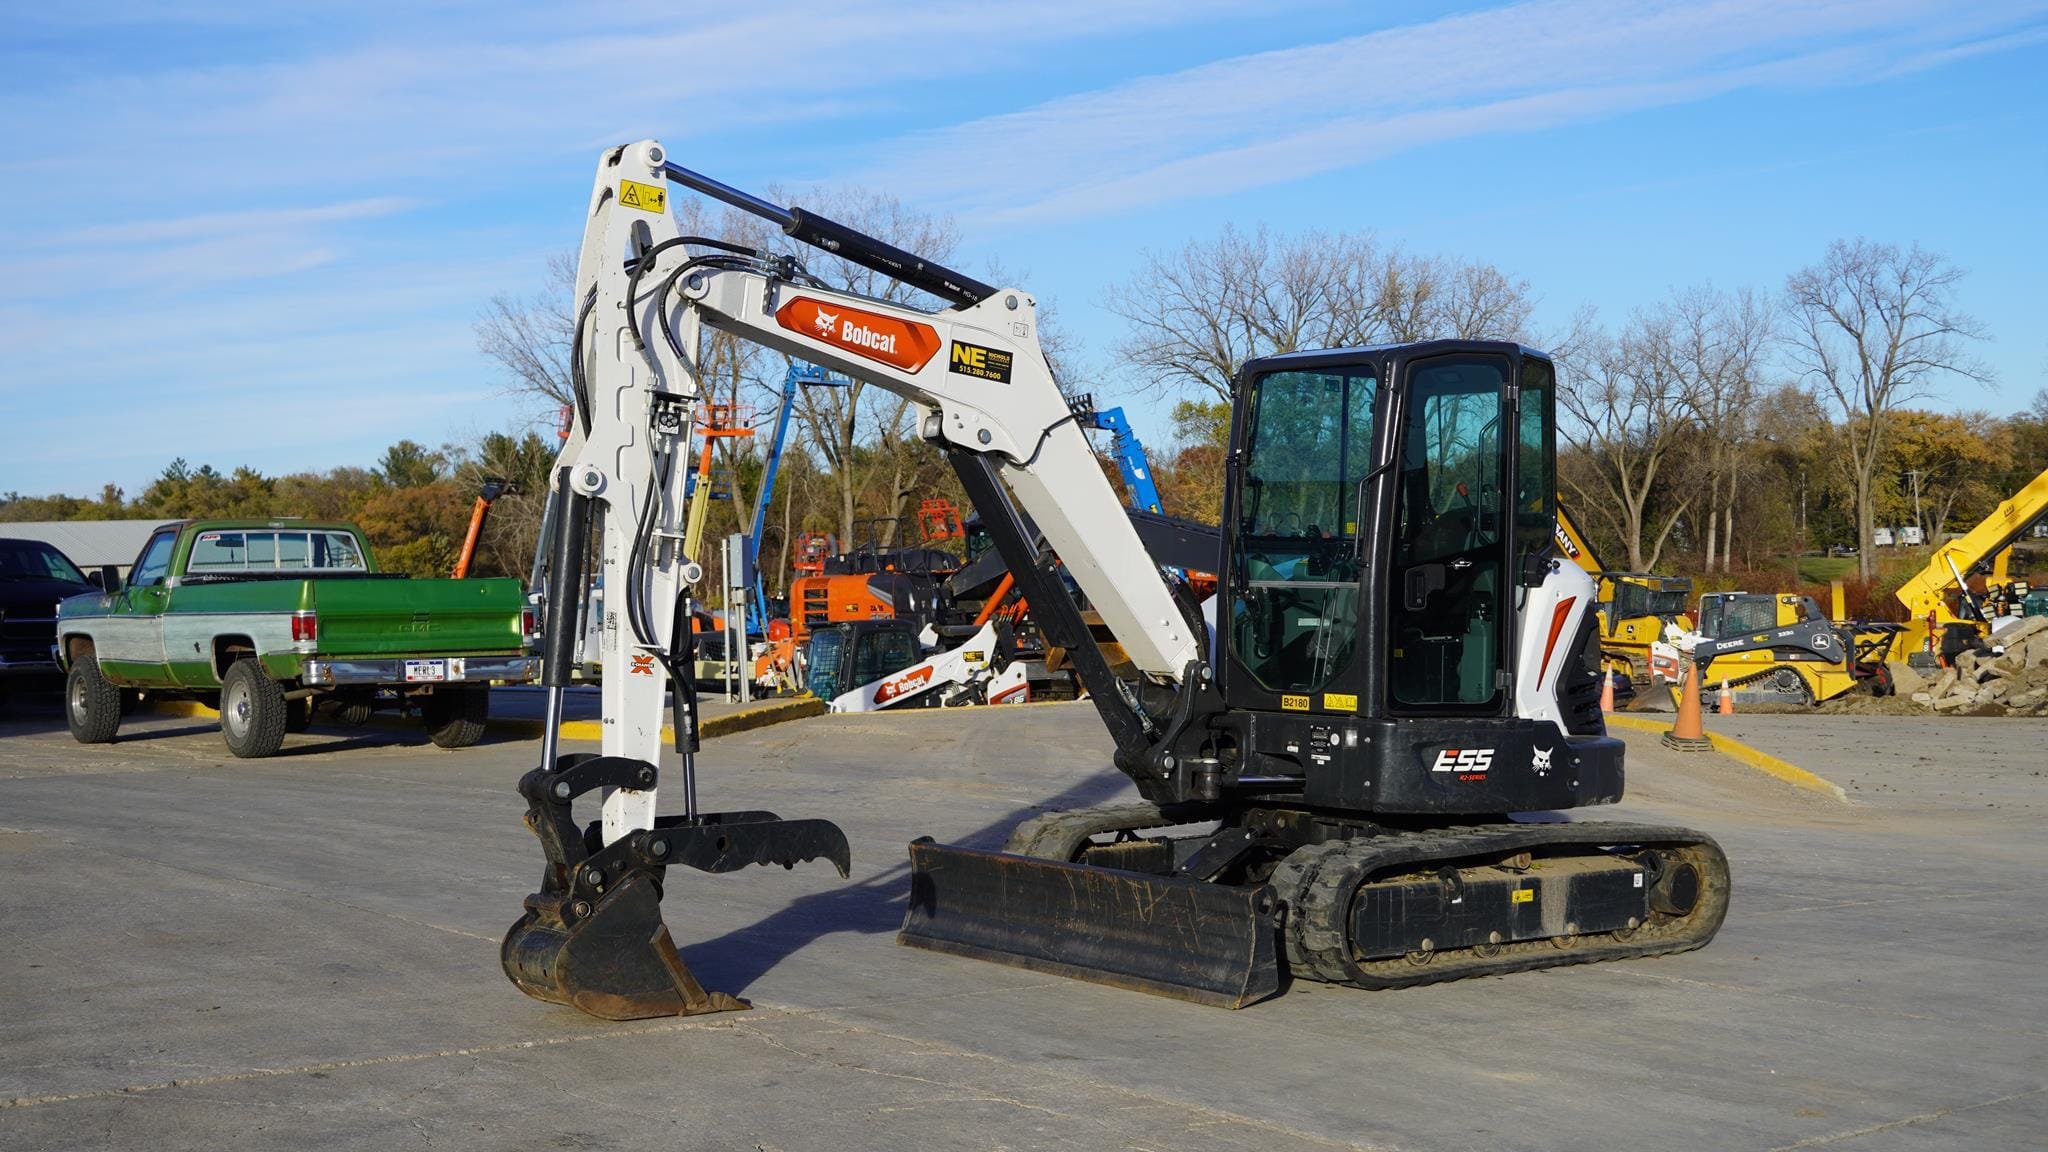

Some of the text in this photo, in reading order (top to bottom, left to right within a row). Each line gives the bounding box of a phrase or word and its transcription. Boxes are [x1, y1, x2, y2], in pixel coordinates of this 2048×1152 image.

[842, 320, 896, 354] Bobcat
[952, 343, 986, 368] NE
[959, 365, 1001, 380] 515.280.7600
[399, 623, 440, 633] GMC
[1716, 640, 1745, 650] DEERE
[899, 675, 925, 692] Bobcat
[1283, 697, 1308, 708] B2180
